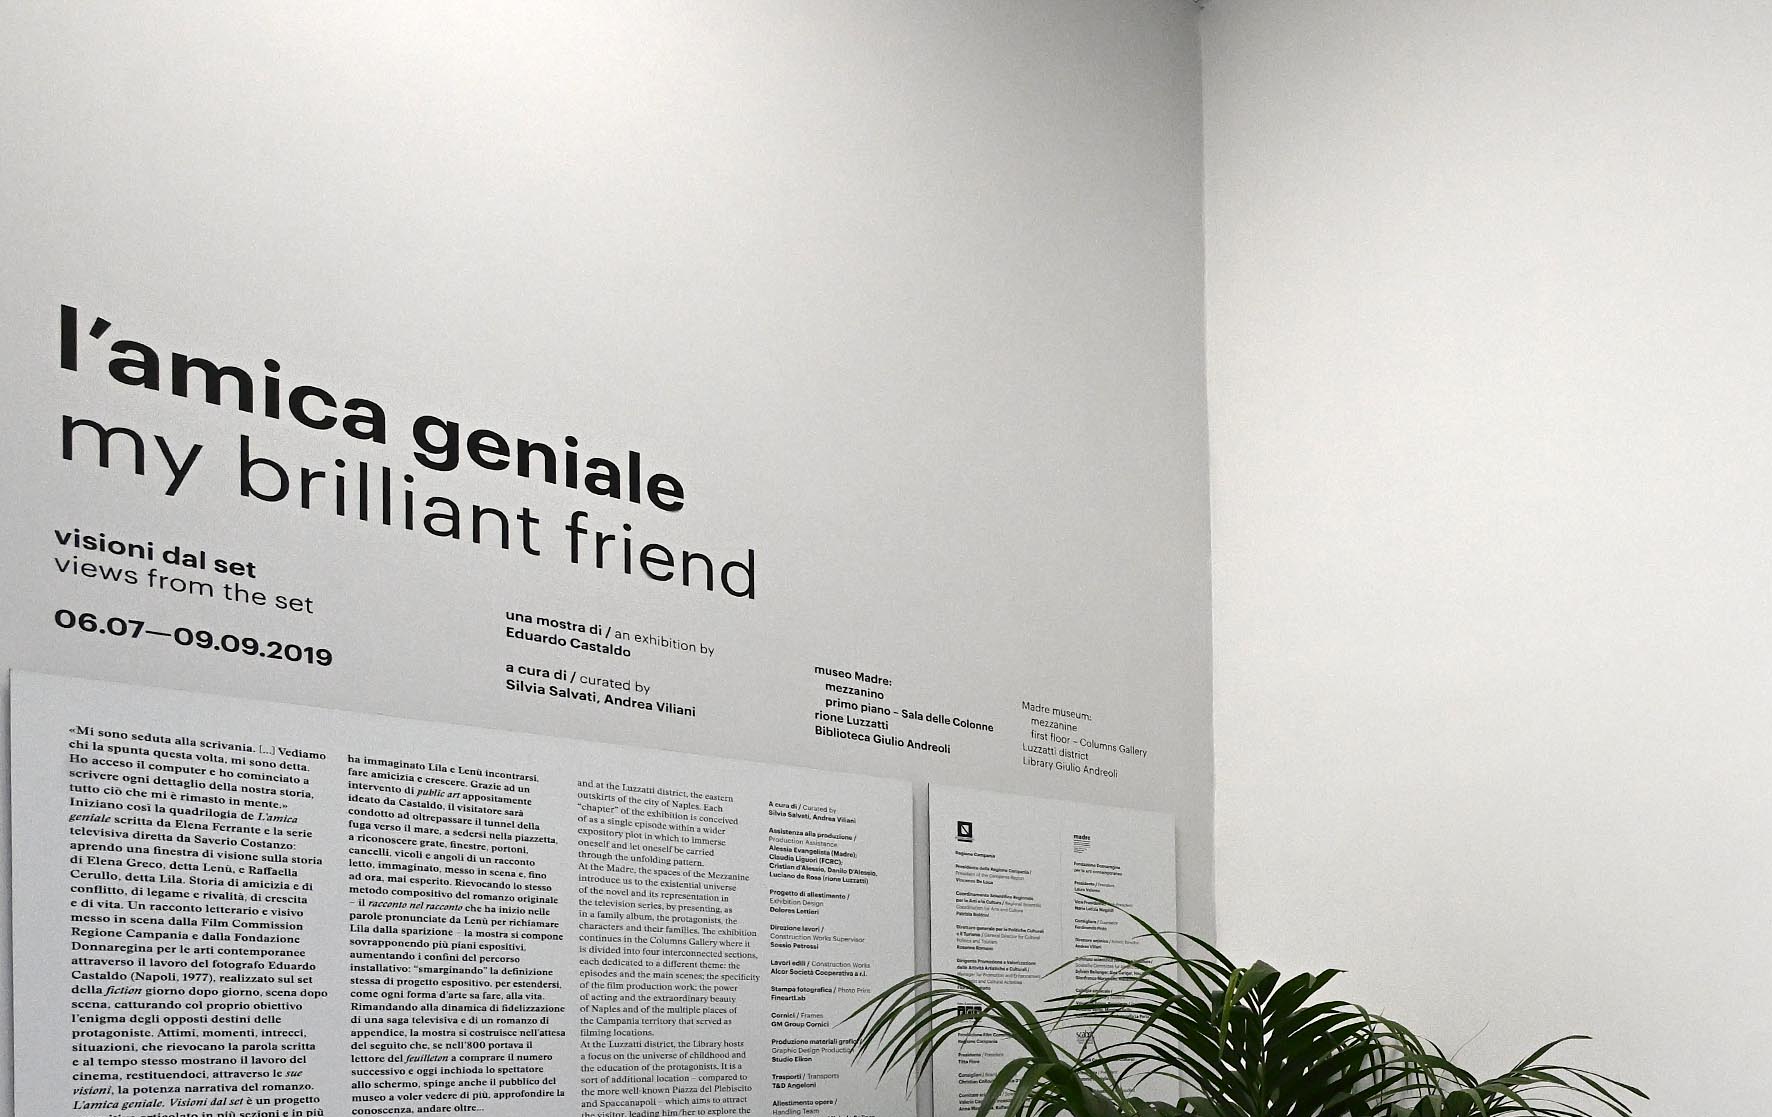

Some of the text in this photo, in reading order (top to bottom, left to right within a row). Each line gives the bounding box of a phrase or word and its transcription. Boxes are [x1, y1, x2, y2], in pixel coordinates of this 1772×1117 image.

[61, 304, 684, 512] l'amica geniale
[63, 415, 754, 599] my brilliant friend
[54, 528, 256, 578] visioni dal set
[54, 556, 313, 614] views from the set
[55, 610, 332, 666] 06.07—09.09.2019
[506, 612, 714, 657] una mostra di / an exhibition by
[506, 627, 631, 657] Eduardo Castaldo
[506, 664, 650, 695] a cura di / curated by
[815, 667, 892, 686] museo Madre:
[825, 683, 884, 699] mezzanino
[506, 679, 695, 717] Silvia Salvati, Andrea Viliani
[1022, 701, 1092, 721] Madre museum:
[815, 710, 888, 730] rione Luzzatti
[826, 698, 858, 710] primo
[861, 703, 891, 715] piano
[902, 709, 923, 721] Sala
[926, 713, 950, 725] delle
[953, 718, 994, 732] Colonne
[1031, 718, 1077, 731] mezzanine
[69, 726, 94, 736] «Mi
[98, 731, 128, 739] sono
[132, 733, 171, 744] seduta
[175, 737, 196, 746] alla
[200, 741, 255, 752] scrivania.
[278, 747, 326, 759] Vediamo
[815, 725, 950, 754] Biblioteca Giulio Andreoli
[1023, 743, 1088, 760] Luzzatti district
[1031, 729, 1048, 741] first
[1050, 733, 1070, 743] floor
[1079, 738, 1117, 752] Columns
[1119, 744, 1147, 758] Gallery
[348, 754, 360, 763] ha
[364, 756, 425, 770] immaginato
[428, 763, 447, 772] Lila
[458, 766, 482, 776] Lenù
[485, 770, 539, 782] incontrarsi,
[1023, 757, 1118, 778] Library Giulio Andreoli
[577, 780, 593, 788] and
[606, 782, 620, 790] the
[622, 783, 655, 794] Luzzatti
[657, 788, 688, 798] district,
[690, 791, 703, 799] the
